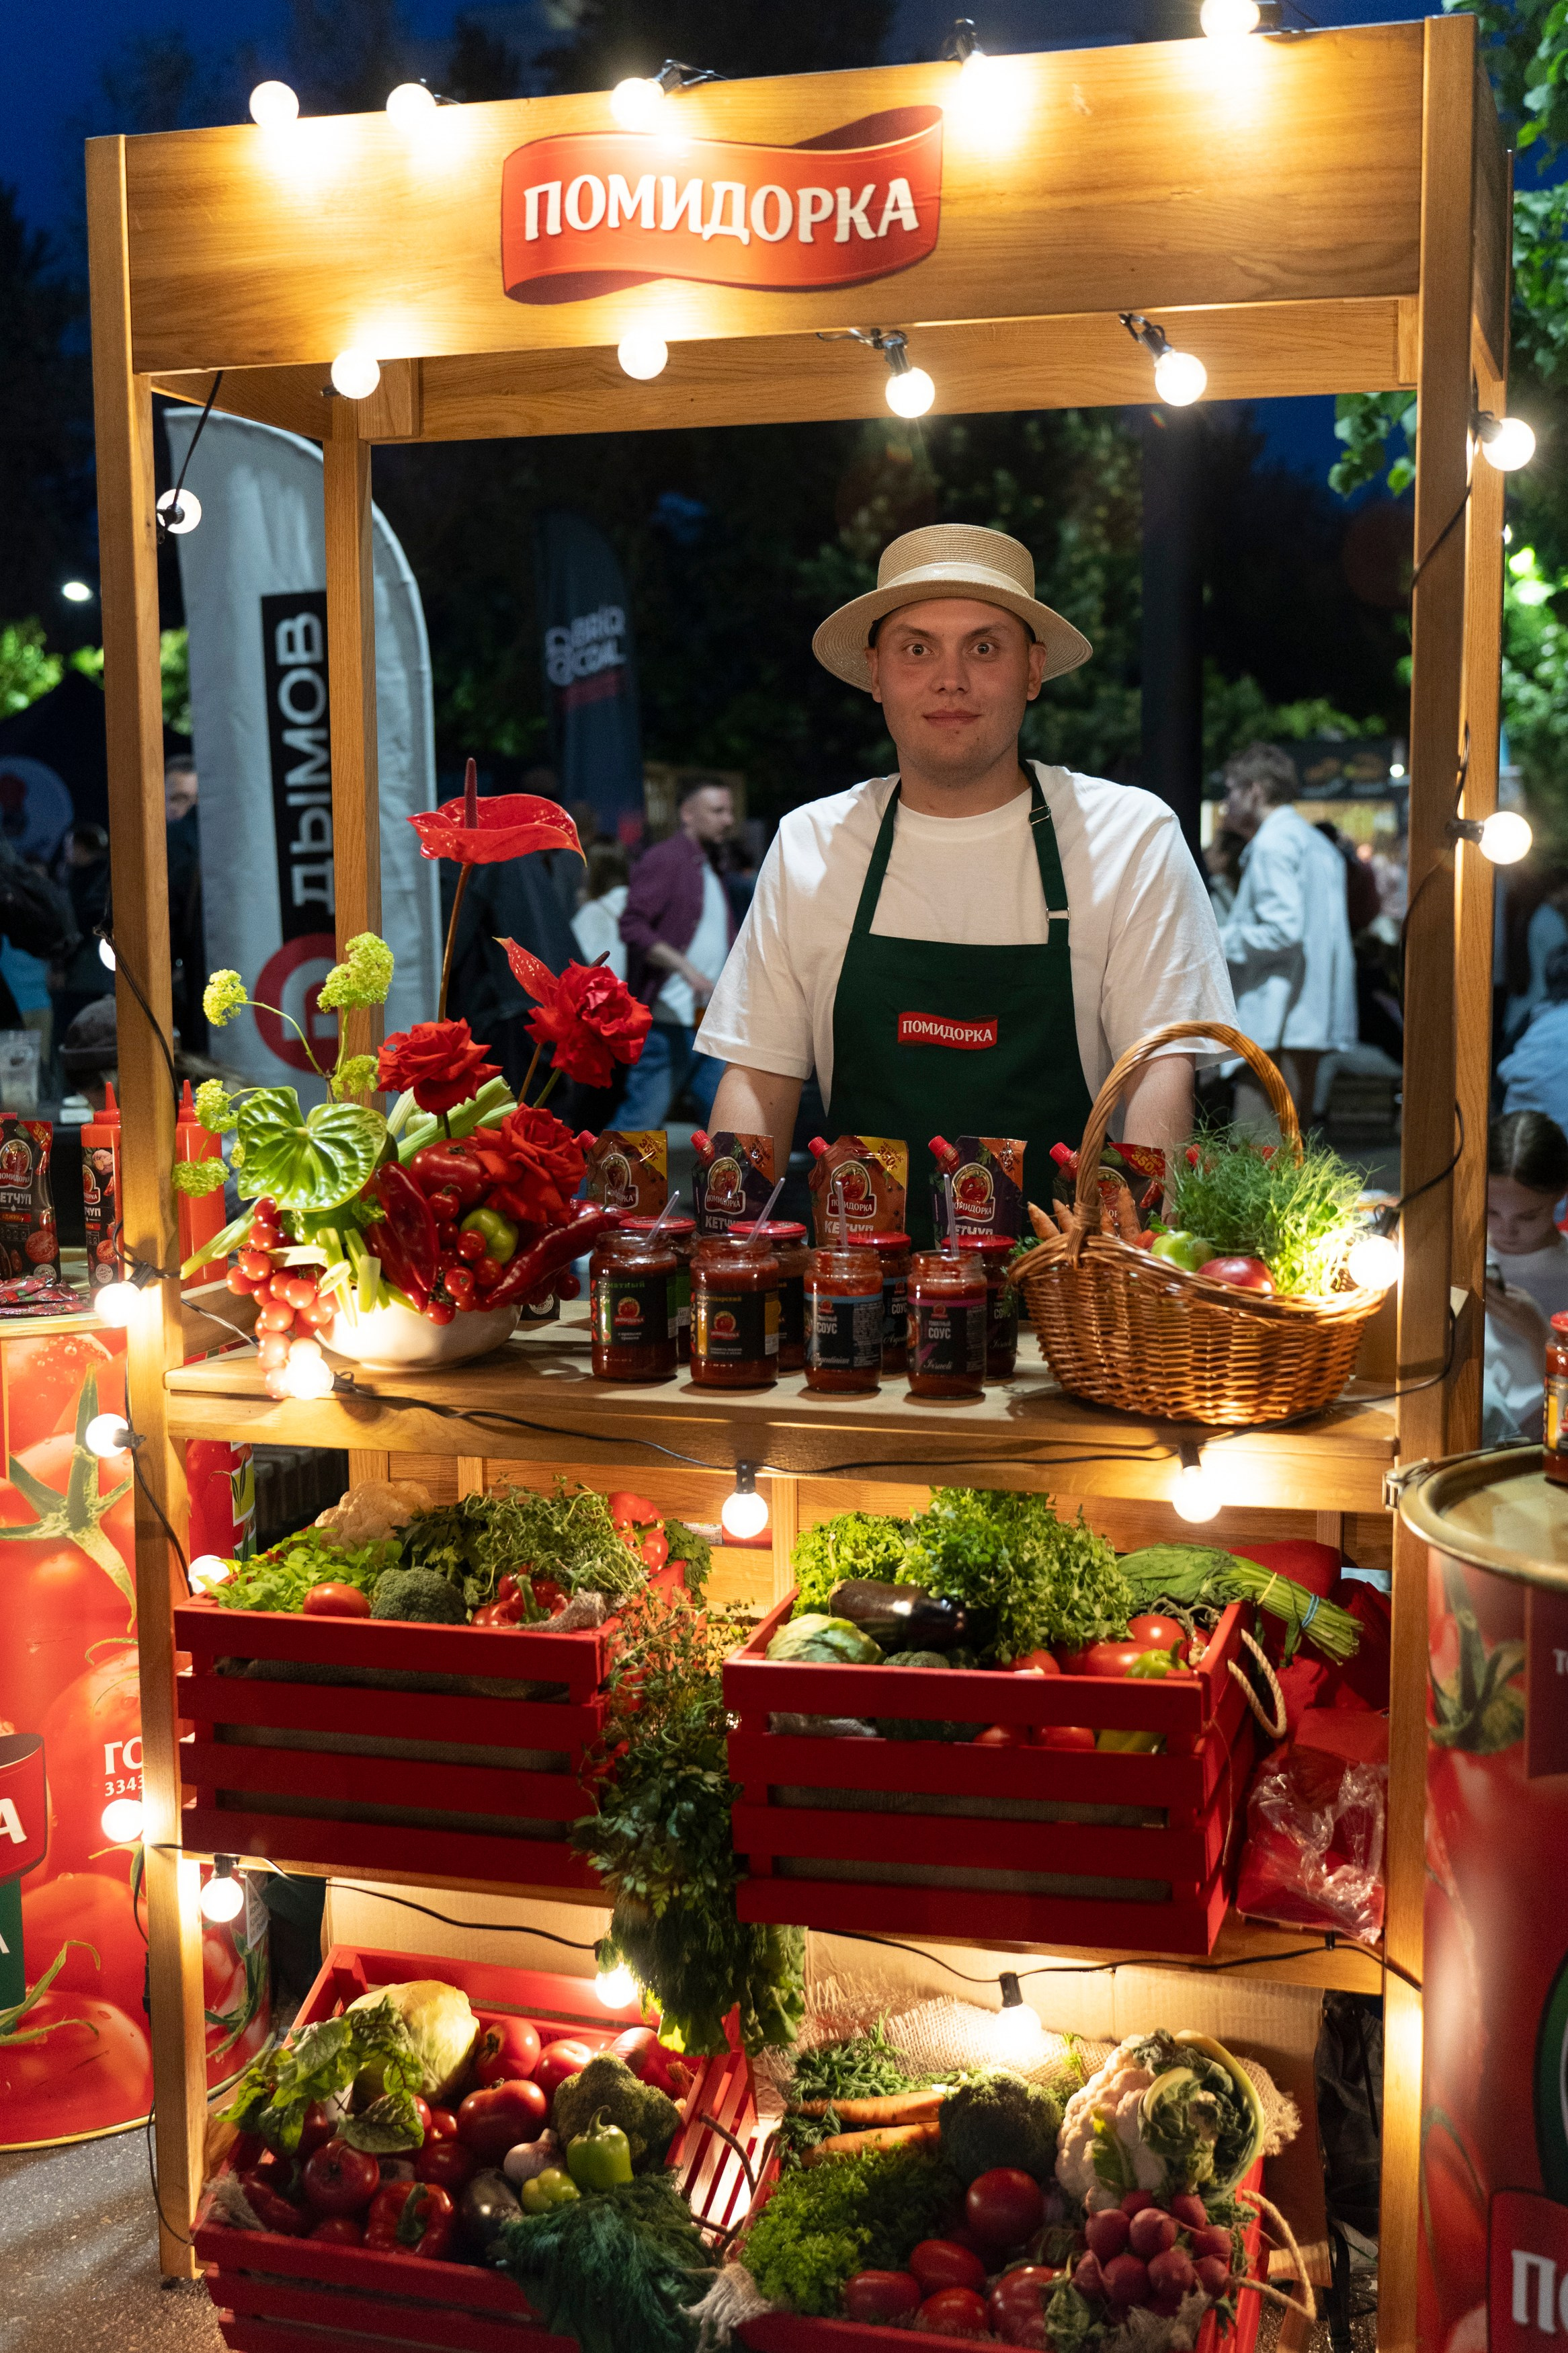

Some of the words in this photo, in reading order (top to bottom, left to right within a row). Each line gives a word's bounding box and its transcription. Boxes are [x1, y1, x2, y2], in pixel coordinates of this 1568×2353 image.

[523, 173, 920, 246] ПОМИДОРКА
[274, 610, 335, 917] ДЫМОВ
[902, 1020, 993, 1042] ПОМИДОРКА
[0, 1192, 32, 1205] ЕТЧУП
[831, 1199, 873, 1212] ПОИДОРКА
[817, 1322, 839, 1334] СОУС
[928, 1327, 952, 1339] СОУС
